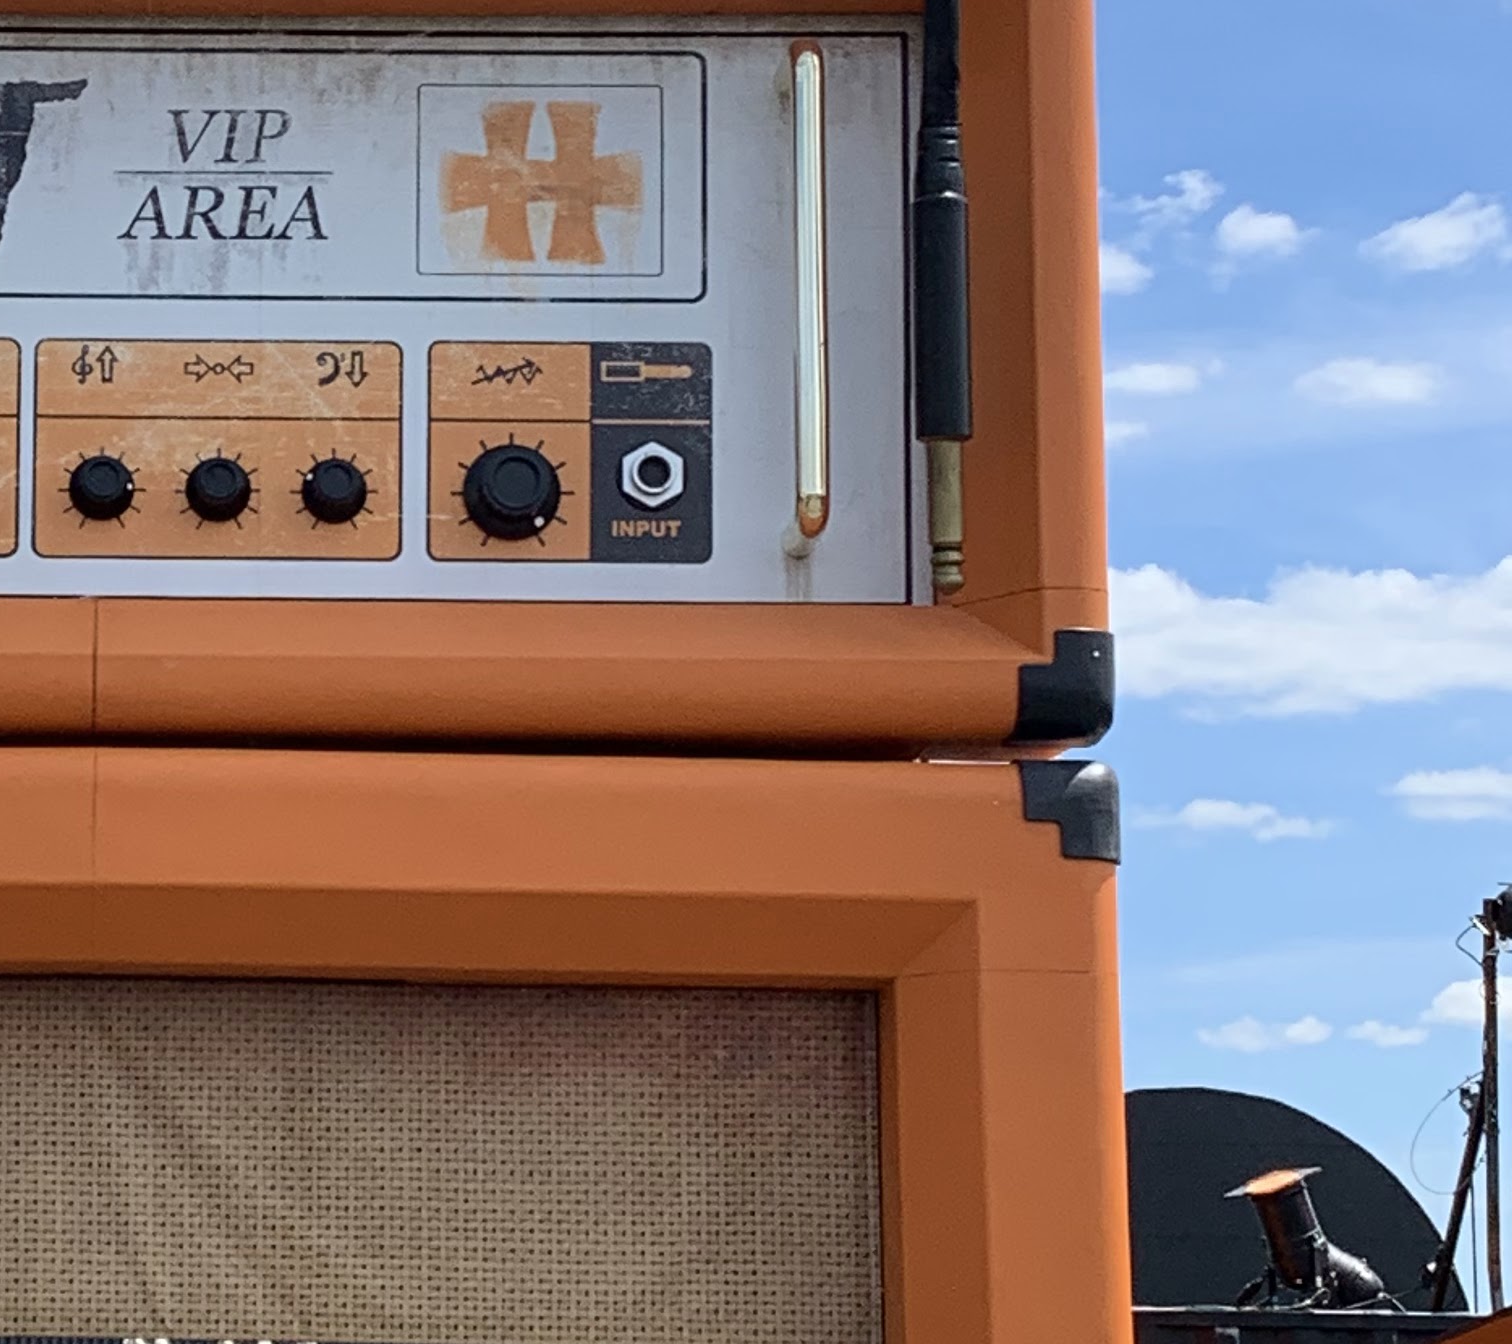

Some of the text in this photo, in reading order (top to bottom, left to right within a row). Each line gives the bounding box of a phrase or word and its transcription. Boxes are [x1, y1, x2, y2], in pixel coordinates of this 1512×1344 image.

[167, 108, 292, 164] VIP
[116, 185, 329, 240] AREA
[611, 520, 682, 538] INPUT
